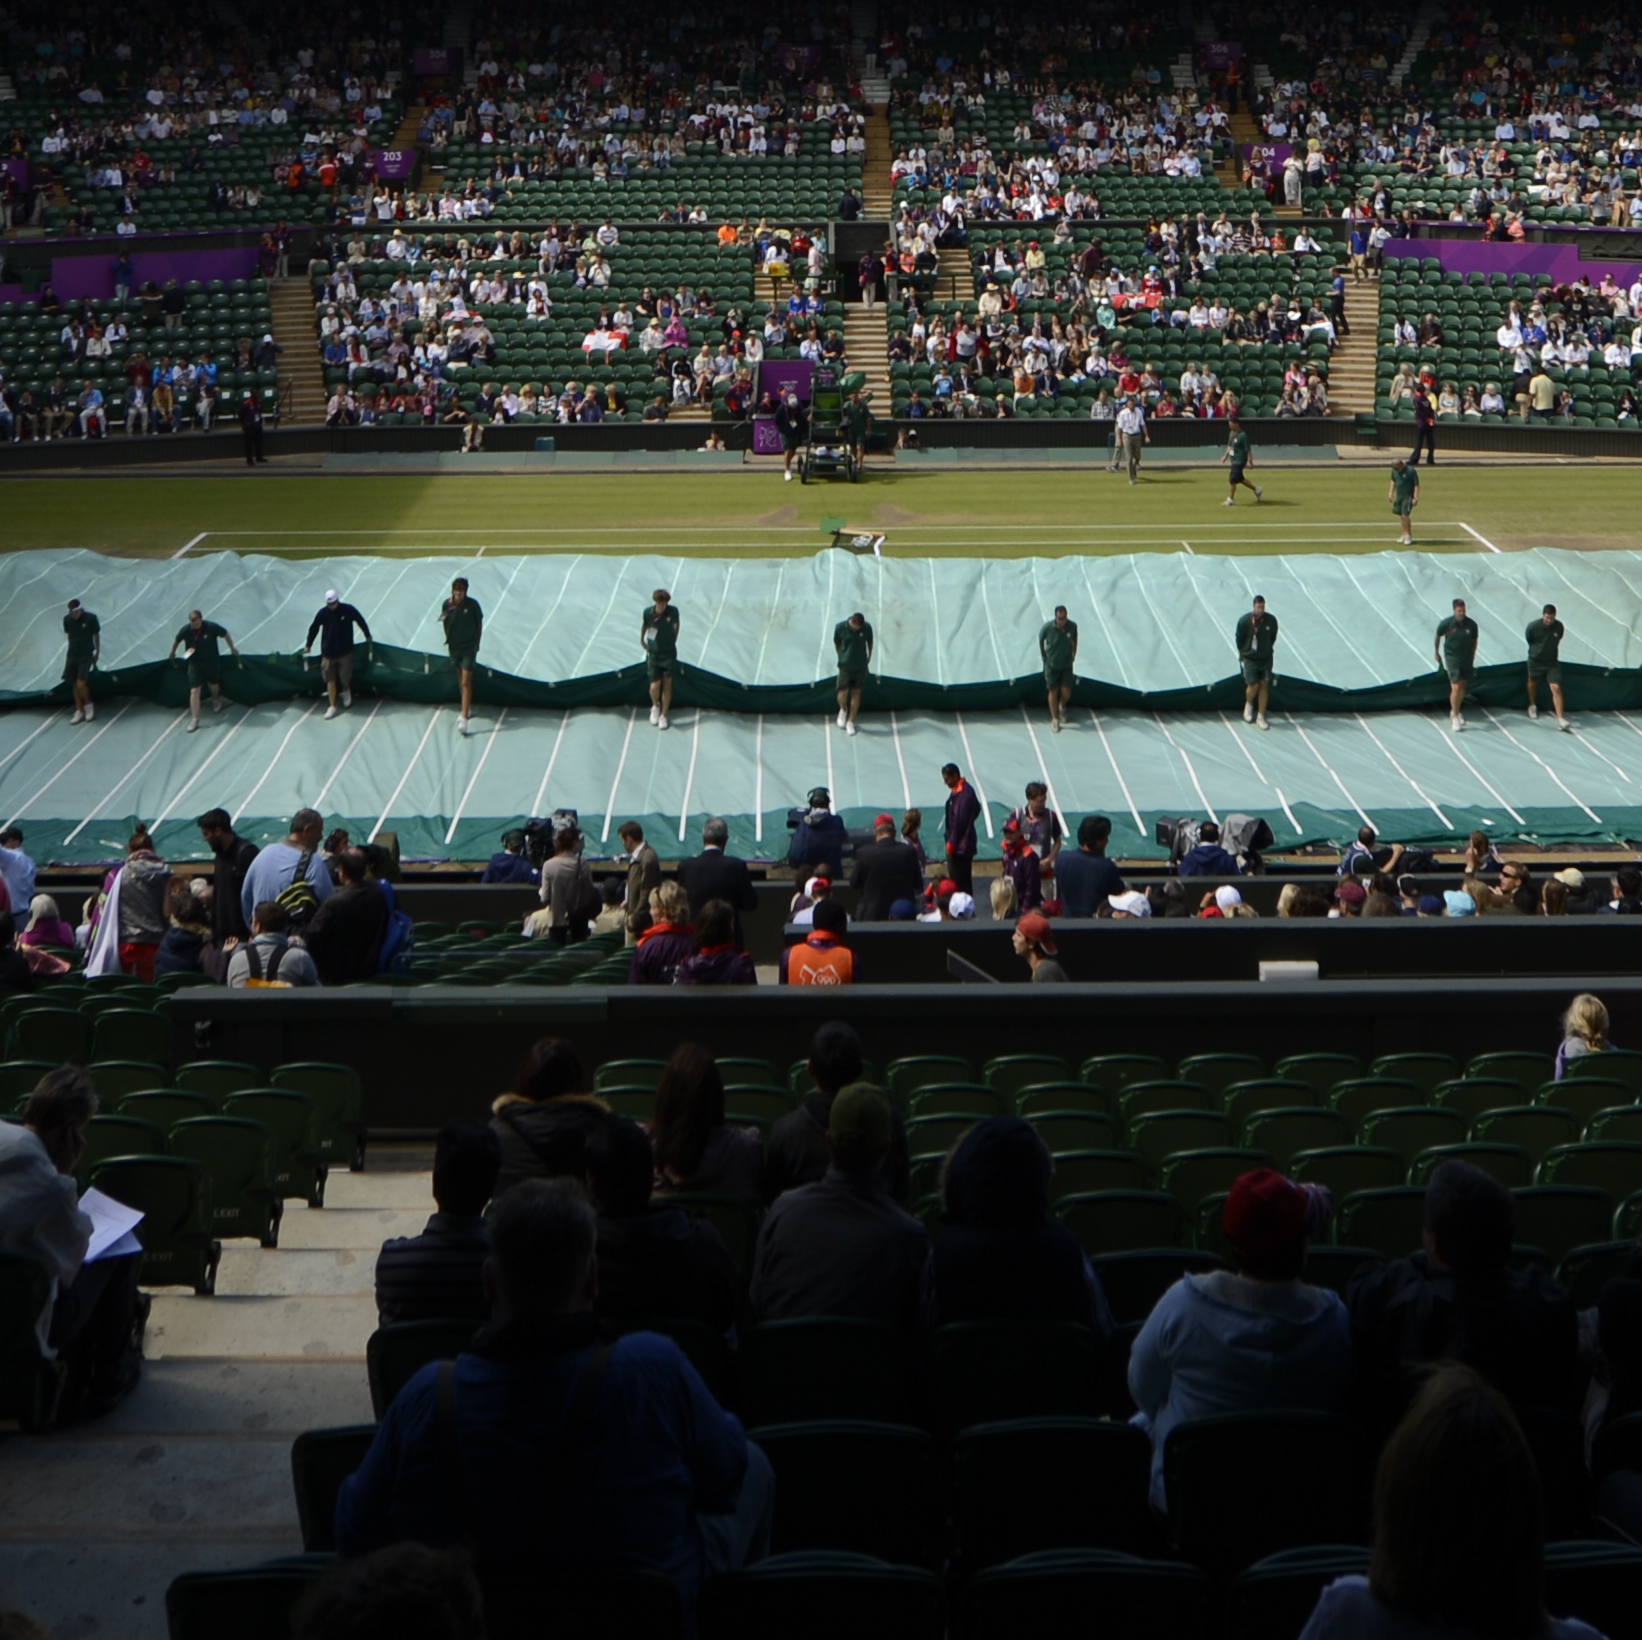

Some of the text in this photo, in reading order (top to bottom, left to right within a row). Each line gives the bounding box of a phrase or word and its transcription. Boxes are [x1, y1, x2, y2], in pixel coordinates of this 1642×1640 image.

[1210, 44, 1228, 53] 306
[428, 50, 447, 59] 304
[383, 151, 402, 161] 203
